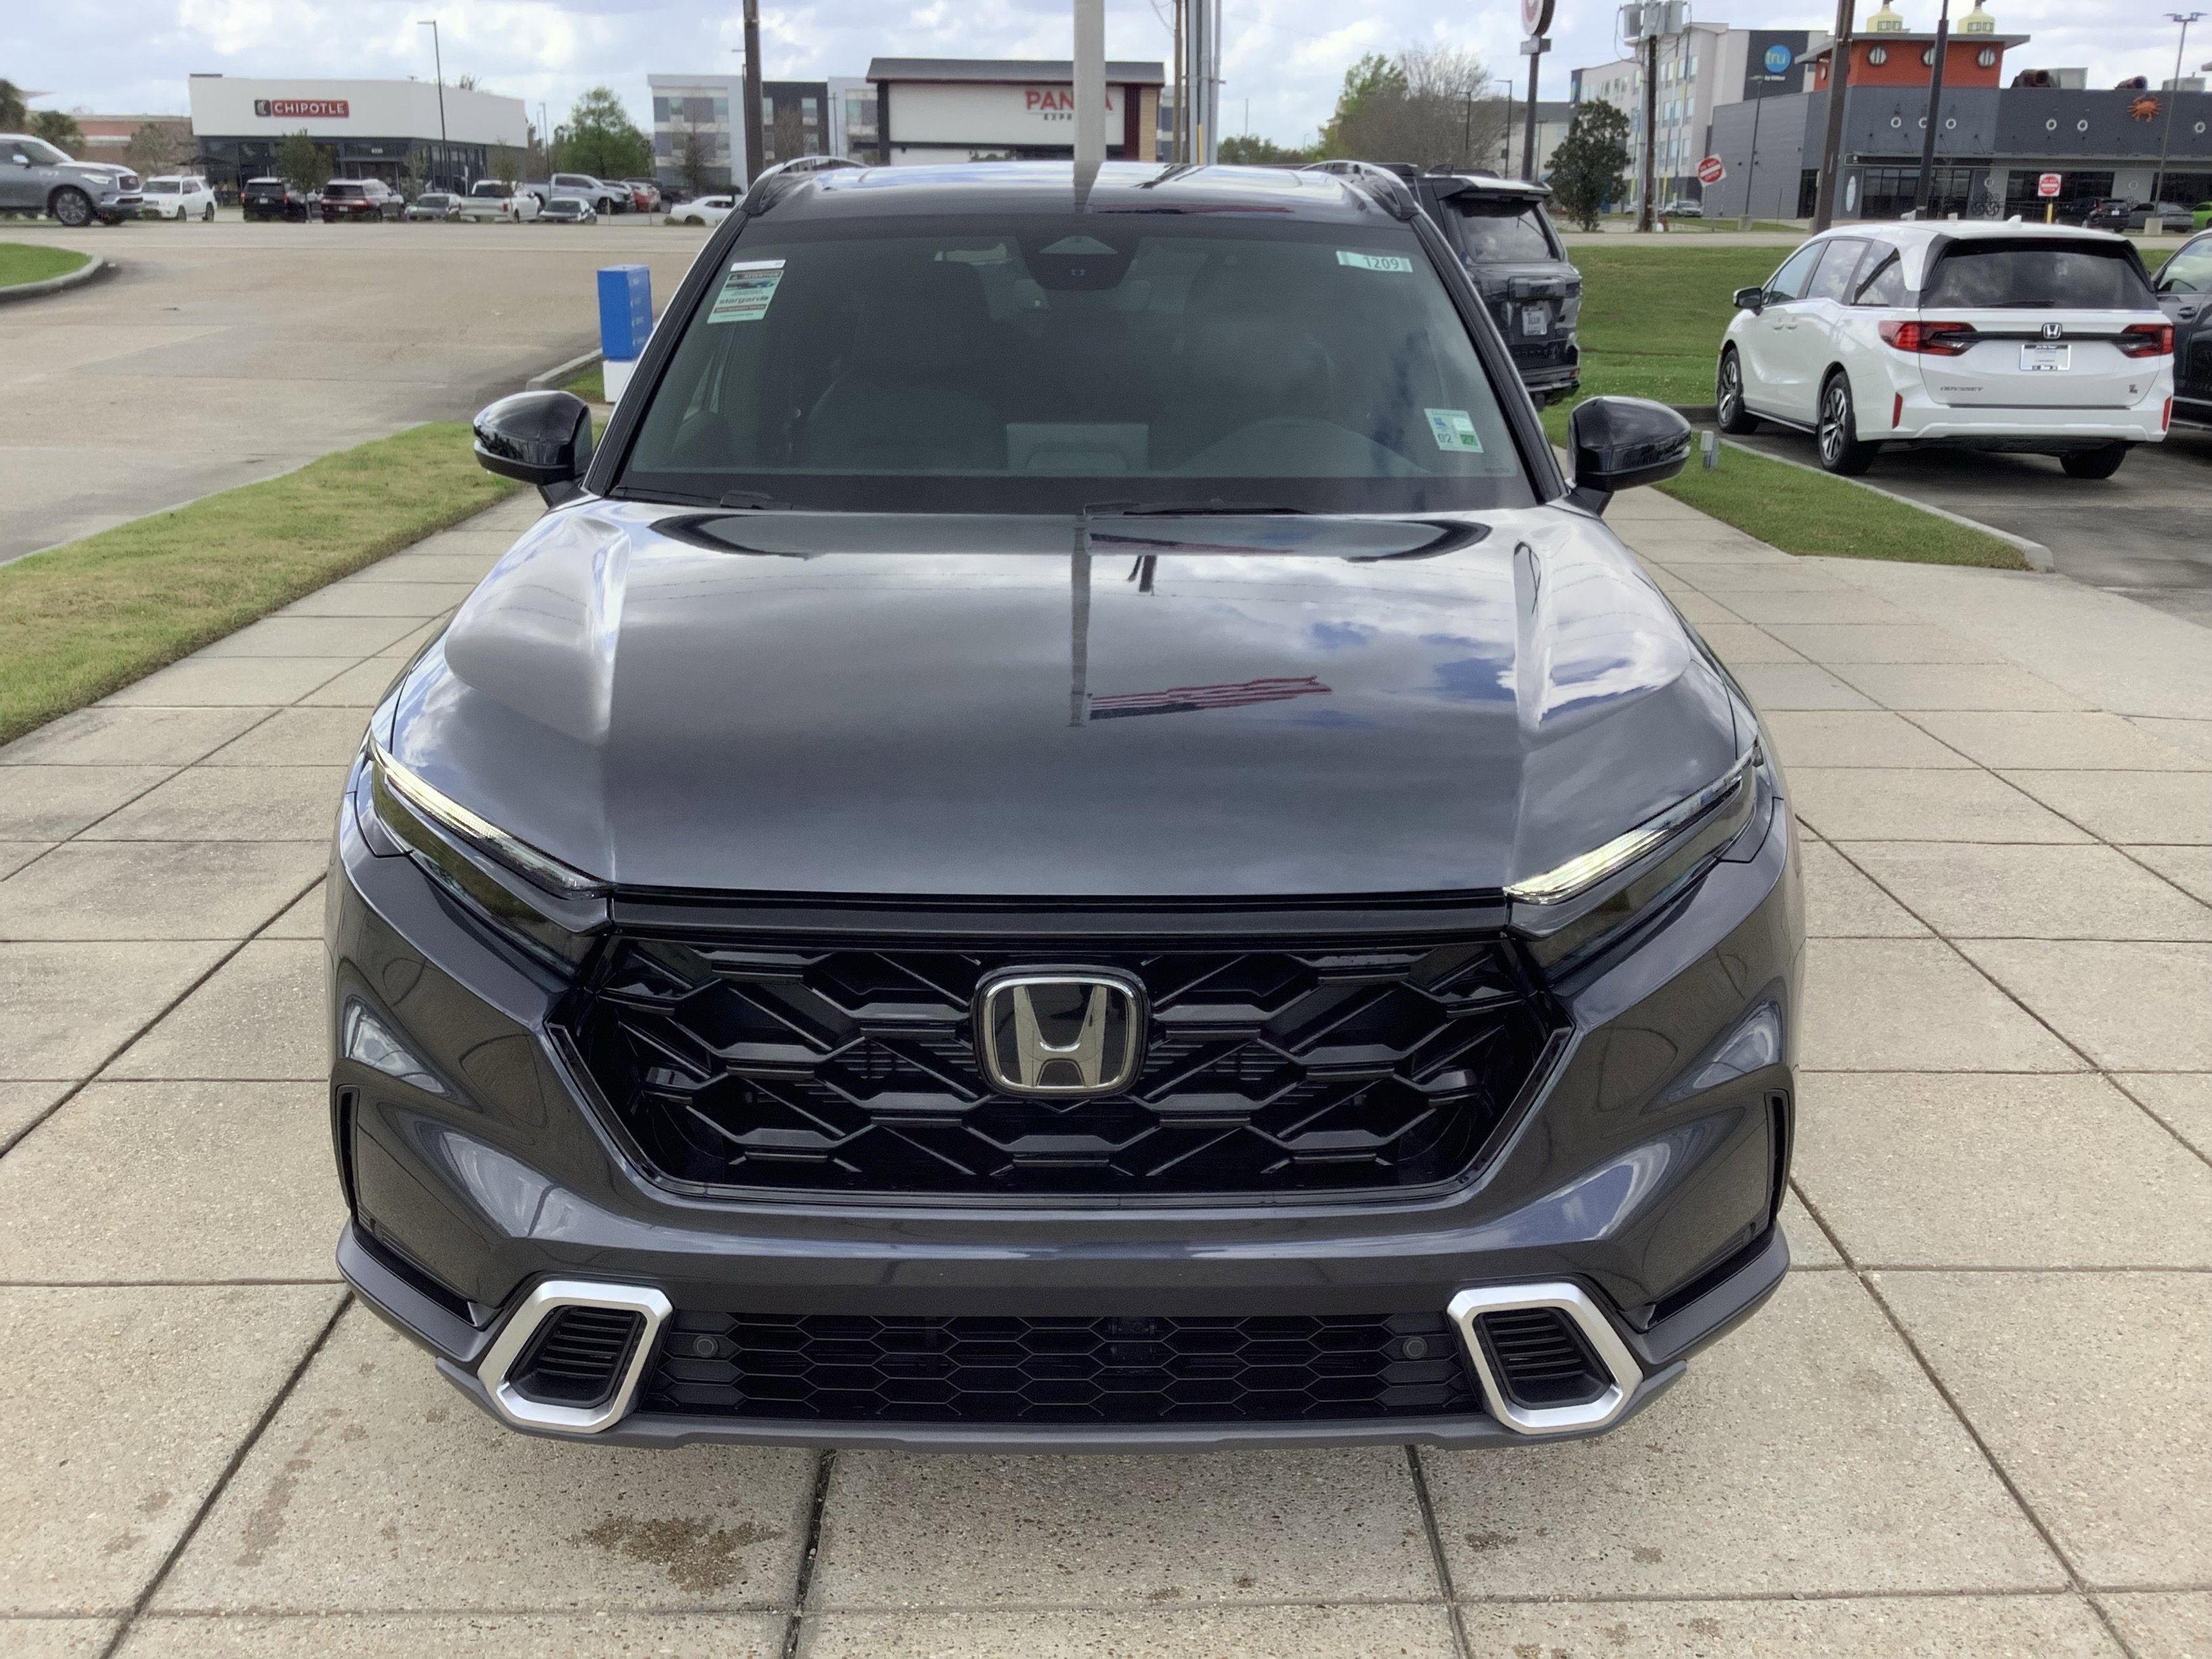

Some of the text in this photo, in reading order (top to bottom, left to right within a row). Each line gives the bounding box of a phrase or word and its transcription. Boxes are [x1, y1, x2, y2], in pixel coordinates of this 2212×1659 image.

[1025, 89, 1113, 110] PAN
[274, 102, 345, 115] CHIPOTLE
[1363, 257, 1399, 270] 1209
